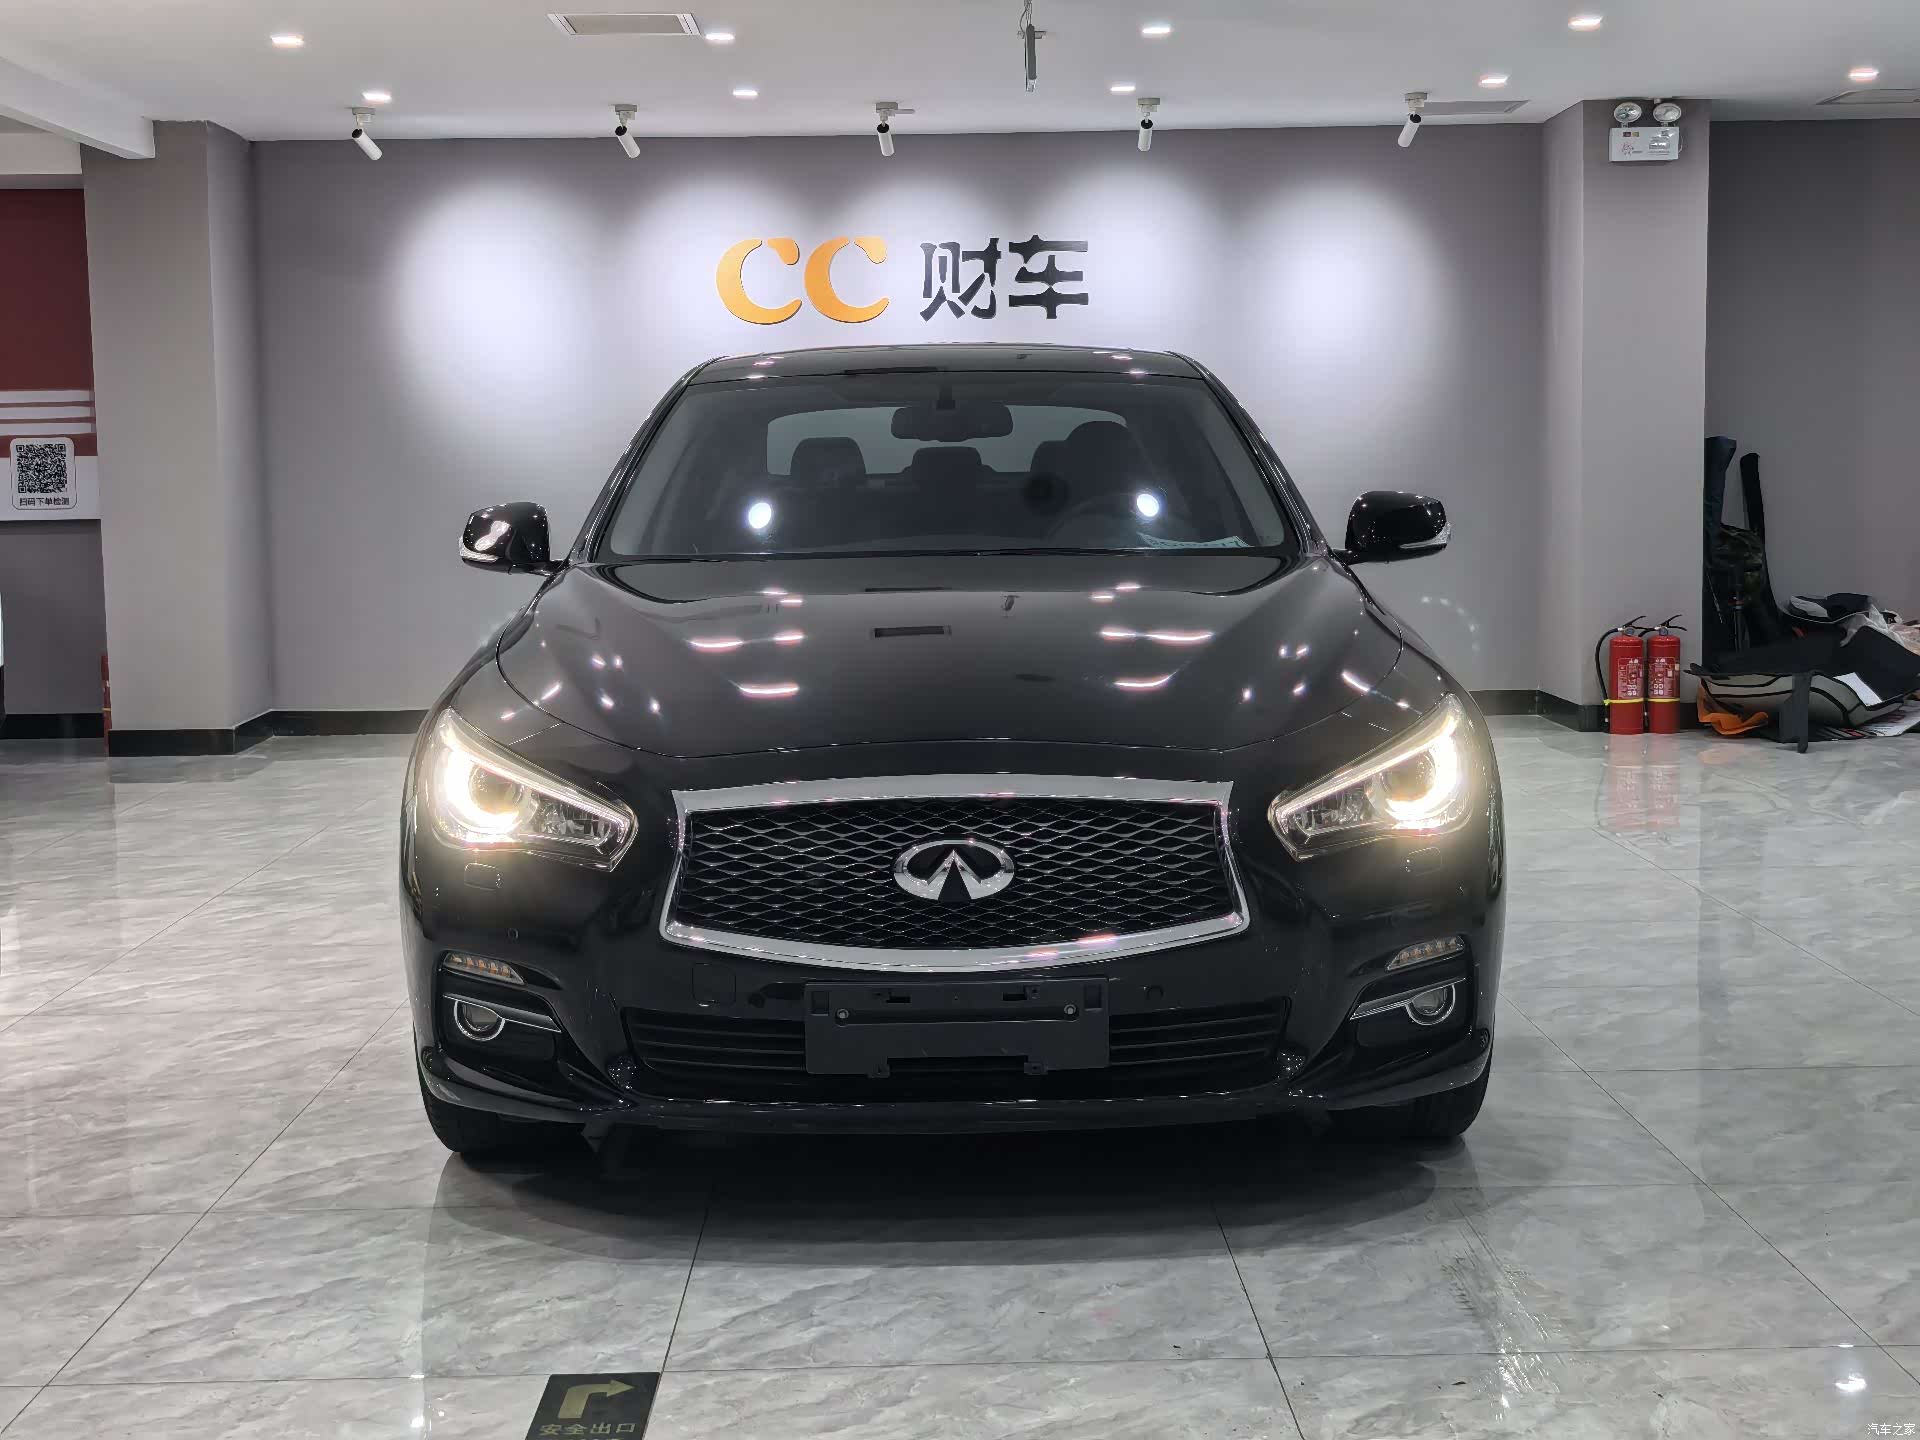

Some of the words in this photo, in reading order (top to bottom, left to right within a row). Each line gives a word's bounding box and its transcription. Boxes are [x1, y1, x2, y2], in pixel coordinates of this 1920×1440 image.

[716, 237, 890, 325] CC
[919, 234, 1089, 322] 财车
[19, 497, 69, 506] 扫码下单检测
[538, 1422, 636, 1435] 安全出口
